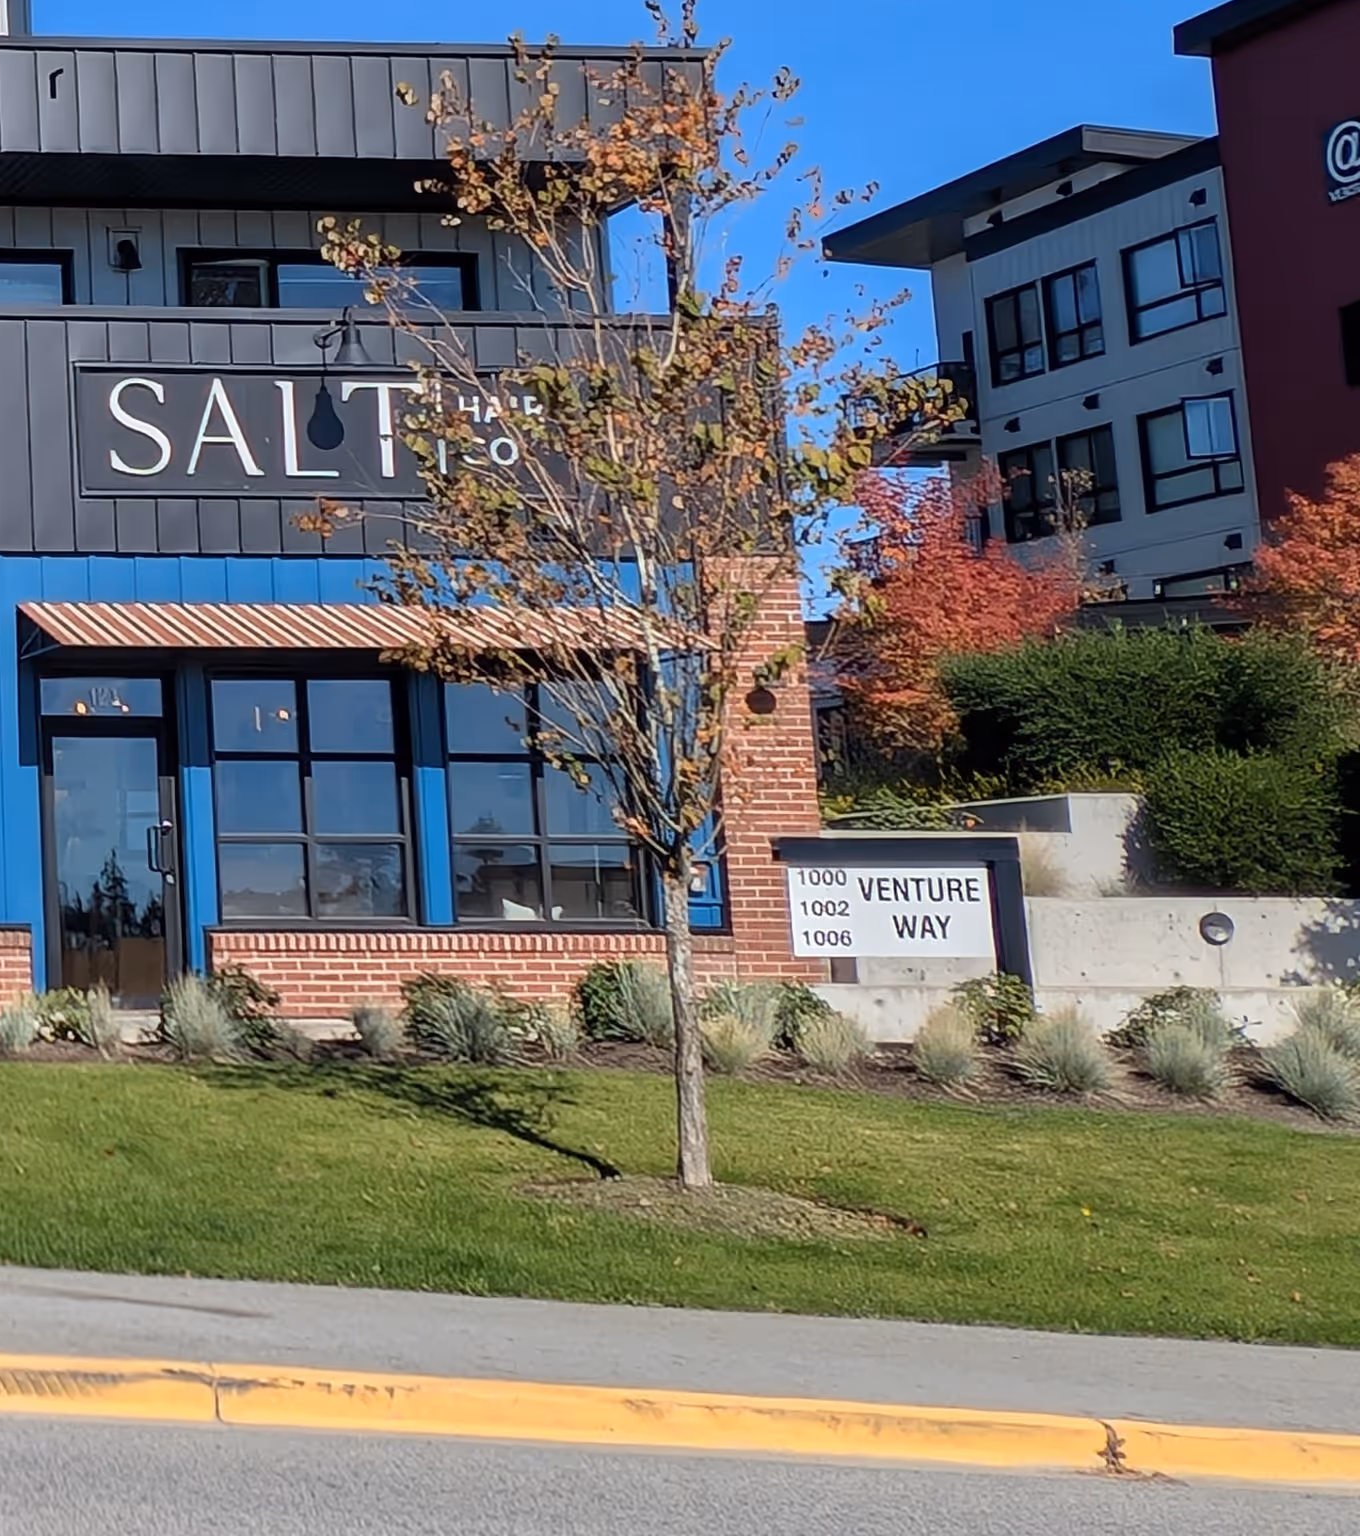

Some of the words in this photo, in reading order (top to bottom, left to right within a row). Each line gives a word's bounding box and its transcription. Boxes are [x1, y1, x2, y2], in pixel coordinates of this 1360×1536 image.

[109, 377, 423, 478] SALT
[797, 868, 847, 886] 1000
[857, 877, 981, 903] VENTURE
[800, 900, 850, 917] 1002
[892, 914, 951, 940] WAY
[802, 930, 853, 947] 1006
